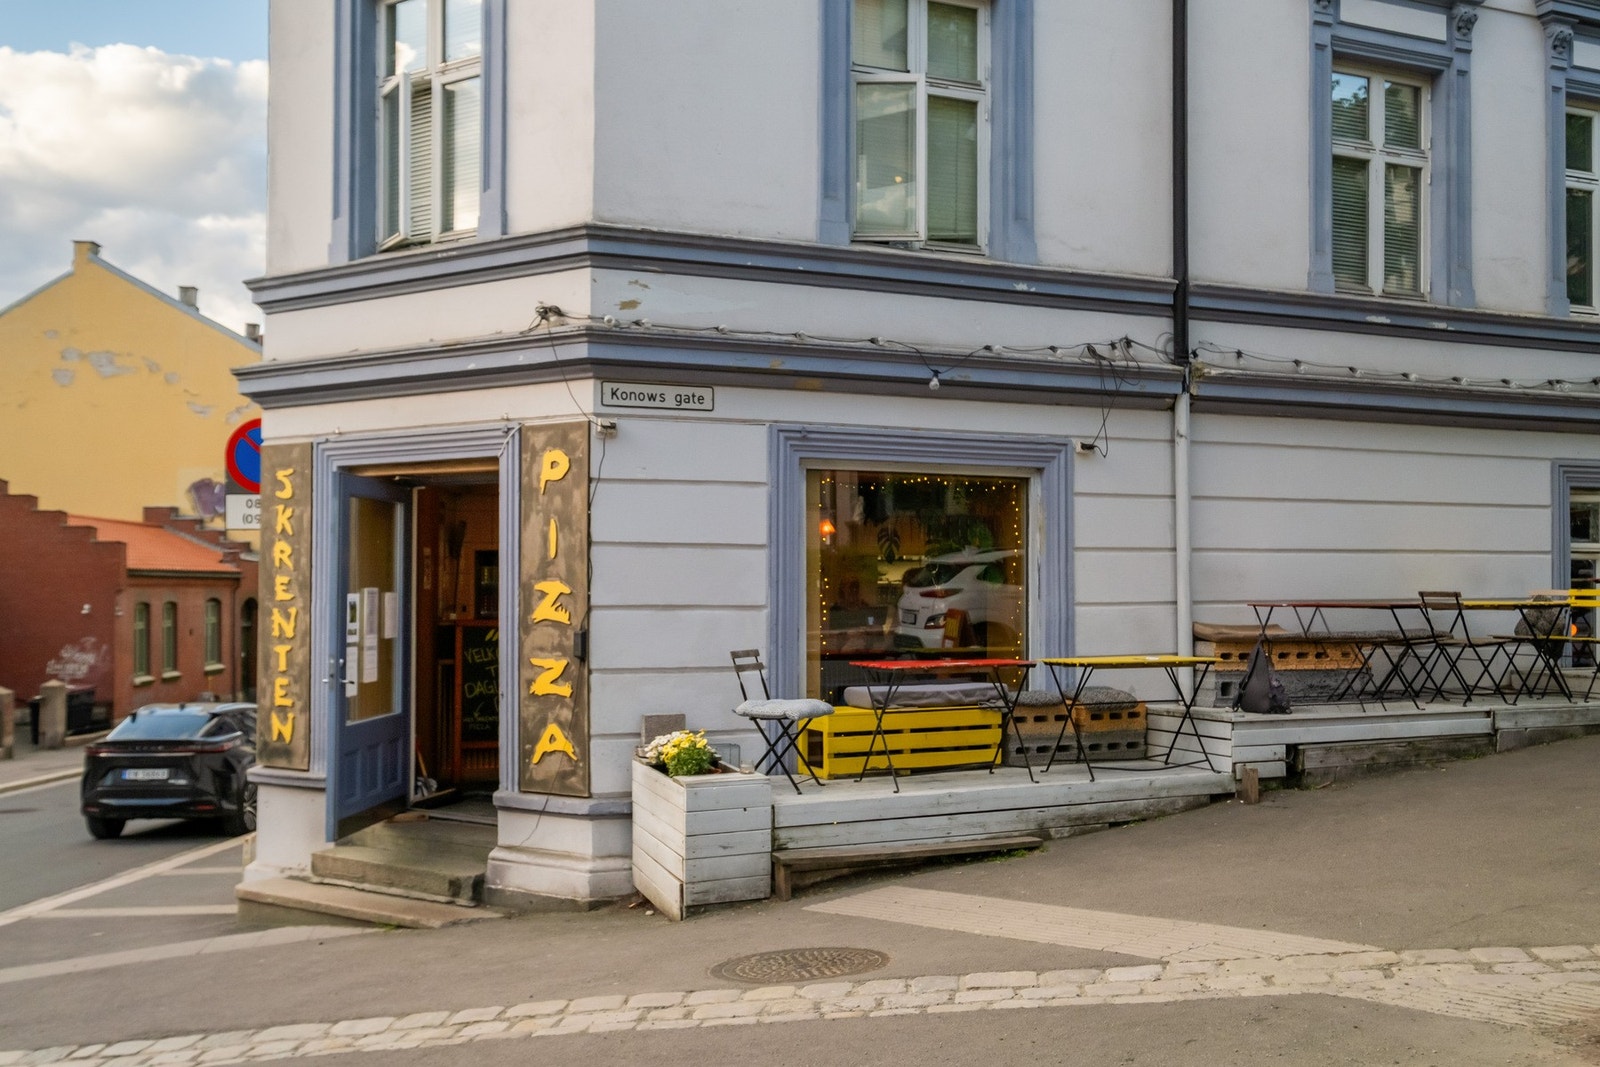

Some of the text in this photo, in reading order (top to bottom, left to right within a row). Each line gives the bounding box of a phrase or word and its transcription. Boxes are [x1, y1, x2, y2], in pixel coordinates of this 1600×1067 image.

[611, 387, 705, 407] Konows gate
[270, 467, 298, 745] SKRENTEN
[529, 448, 579, 765] PIZZA
